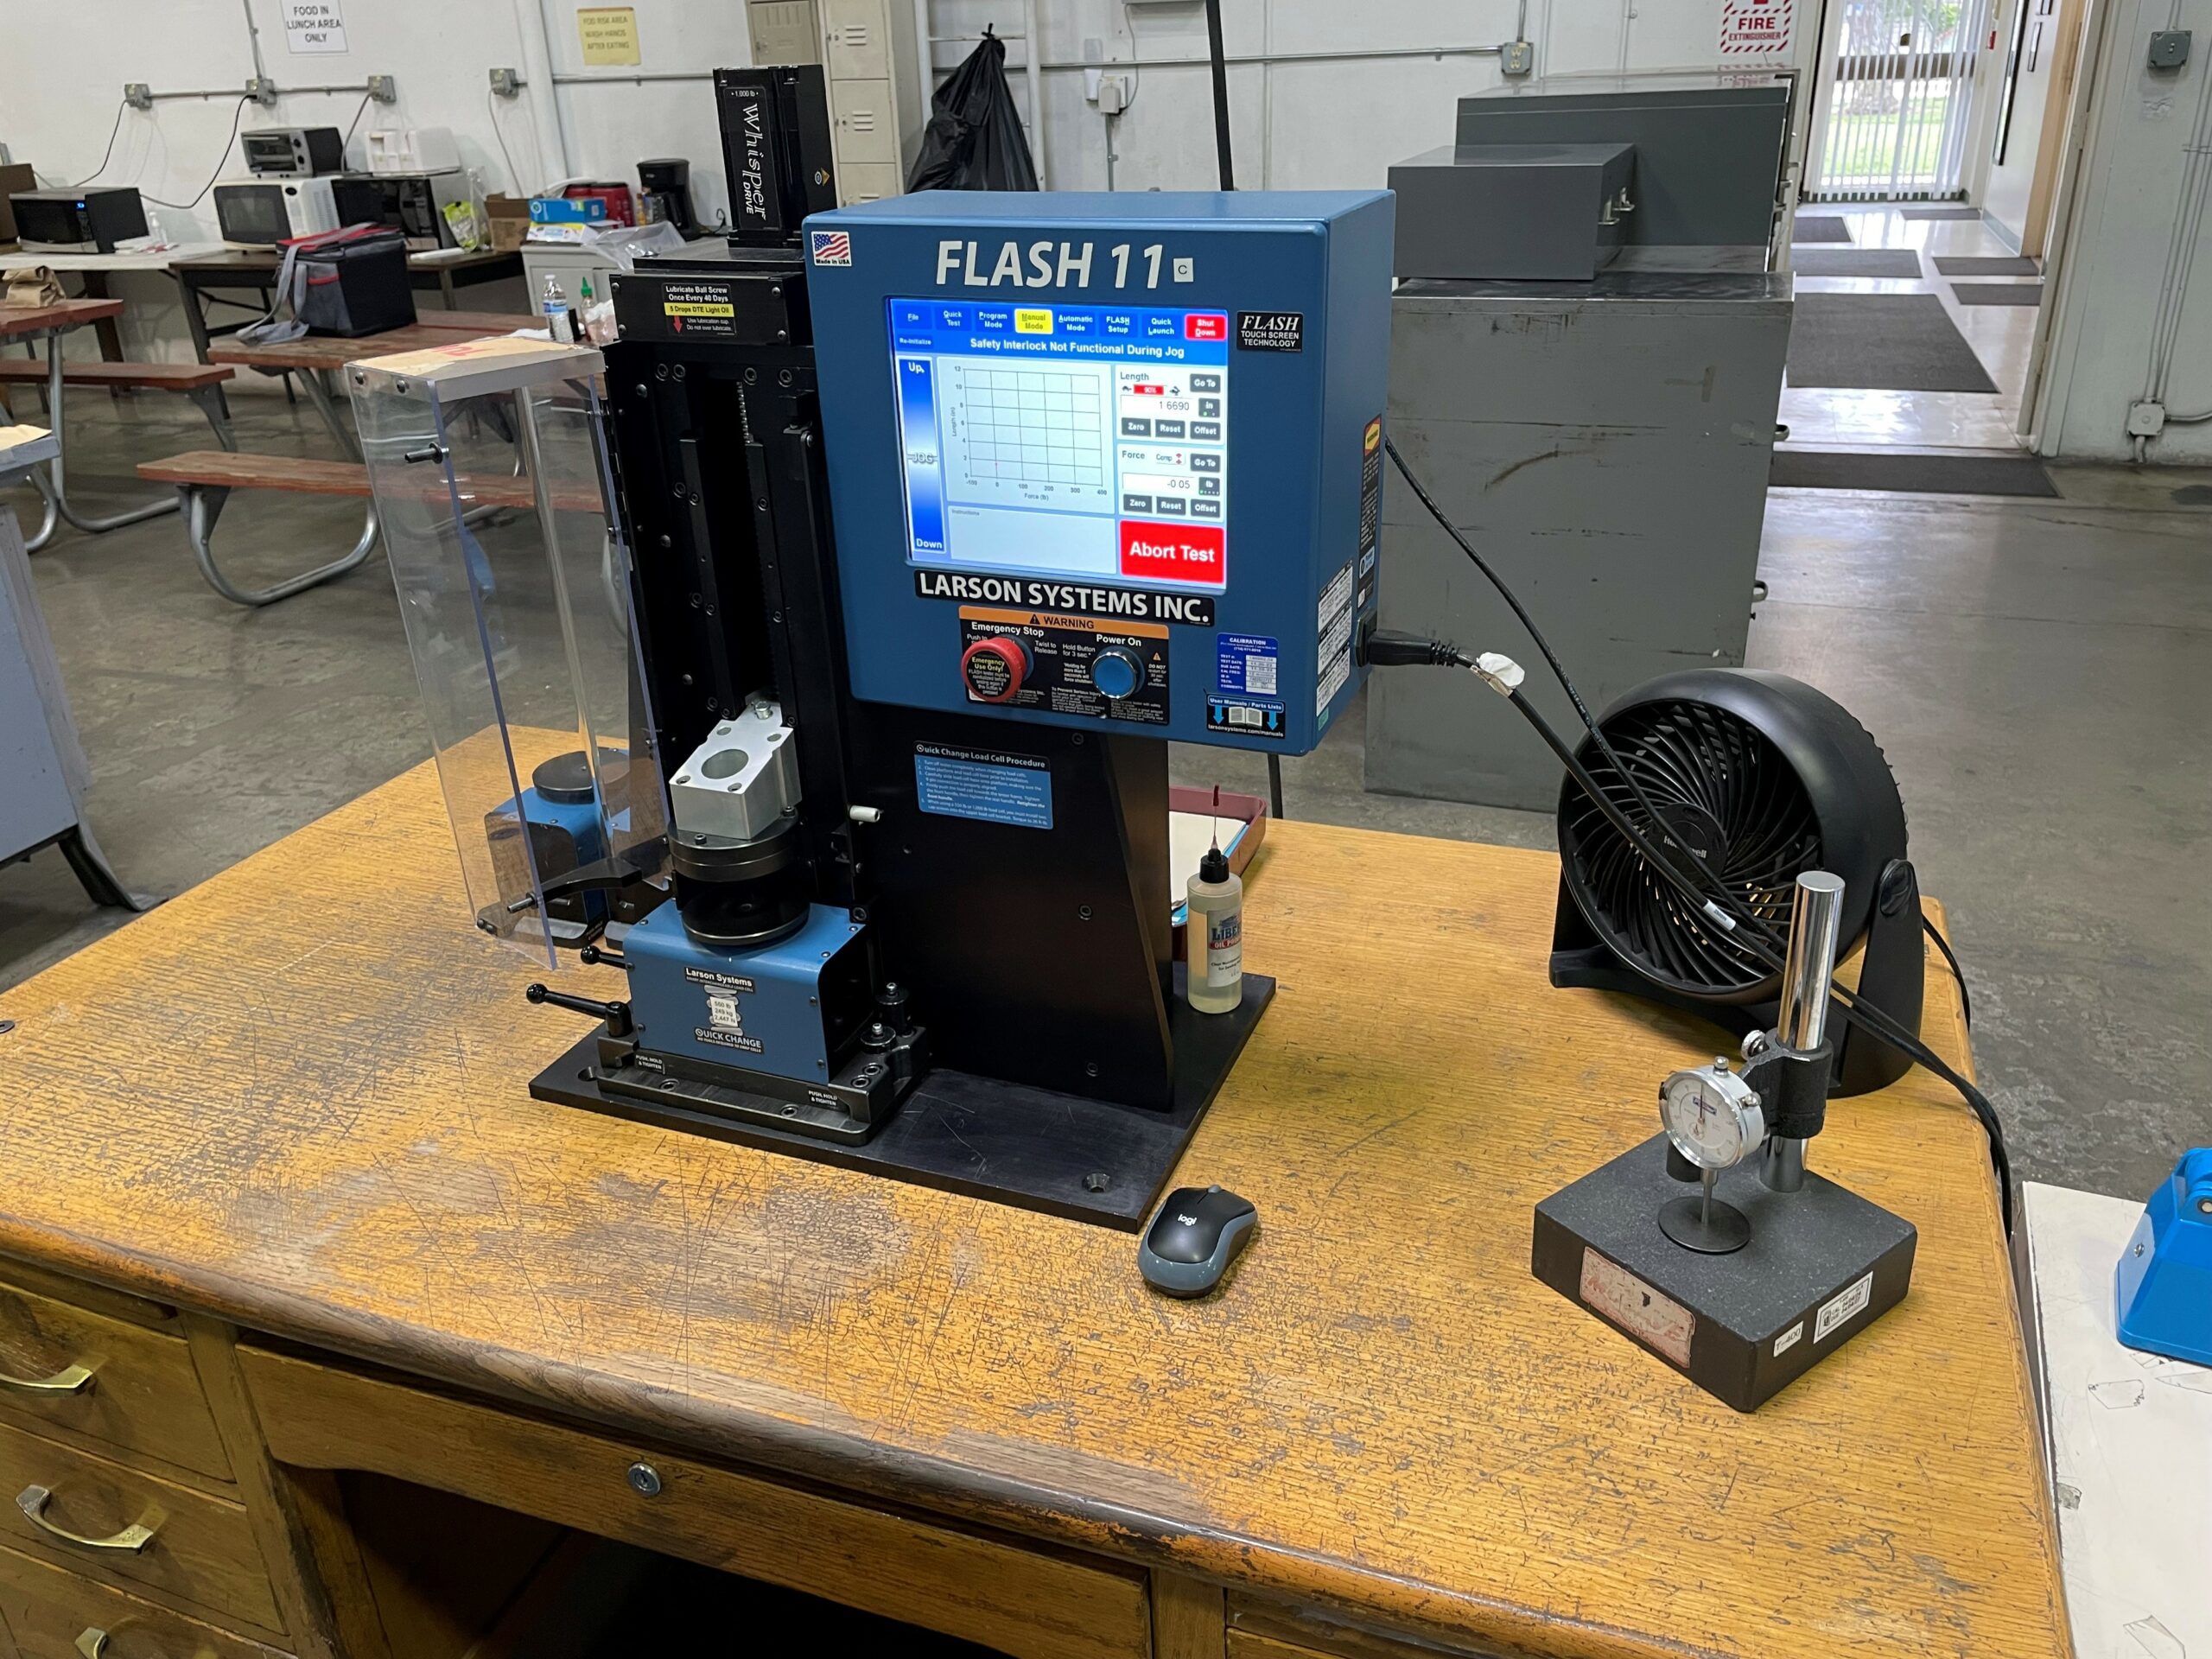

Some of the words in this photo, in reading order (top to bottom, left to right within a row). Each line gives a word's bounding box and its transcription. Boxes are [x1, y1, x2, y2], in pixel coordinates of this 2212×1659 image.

[294, 6, 318, 16] FOOD
[320, 6, 328, 15] IN
[287, 20, 315, 29] LUNCH
[318, 19, 342, 28] AREA
[1738, 17, 1776, 29] FIRE
[305, 33, 327, 42] ONLY
[1729, 32, 1780, 41] EXTINGUISHER
[742, 103, 766, 220] Whisper
[742, 182, 753, 214] DRIVE
[936, 240, 1093, 288] FLASH
[1111, 245, 1163, 289] 11
[944, 310, 962, 319] Quick
[979, 312, 1007, 321] Program
[1106, 316, 1129, 325] FLASH
[1197, 319, 1214, 327] Shut
[1242, 315, 1300, 331] FLASH
[1195, 328, 1216, 337] Down
[1244, 339, 1296, 347] TECHNOLOGY
[970, 339, 1001, 352] Safety
[1003, 340, 1046, 352] Interlock
[1051, 342, 1067, 352] Not
[1070, 342, 1123, 355] Functional
[1128, 345, 1162, 358] During
[1166, 347, 1185, 359] Jog
[908, 362, 922, 373] Up
[1121, 372, 1149, 382] Length
[1194, 378, 1205, 387] Go
[1160, 401, 1189, 410] 16690
[1160, 424, 1180, 433] Reset
[1194, 426, 1217, 435] Offset
[912, 452, 933, 463] JOG
[1122, 450, 1145, 459] Force
[1194, 458, 1205, 467] Go
[1207, 459, 1216, 467] To
[1167, 479, 1190, 489] -005
[1161, 501, 1181, 510] Reset
[1195, 504, 1217, 512] Offset
[916, 538, 942, 550] Down
[1129, 541, 1176, 559] Abort
[1179, 545, 1214, 563] Test
[919, 572, 1021, 602] LARSON
[1028, 583, 1148, 615] SYSTEMS
[1155, 595, 1210, 622] INC.
[1044, 616, 1094, 630] WARNING
[972, 622, 1020, 635] Emergency
[1023, 626, 1044, 638] Stop
[1096, 634, 1124, 645] Power
[1128, 638, 1141, 646] On
[972, 657, 1005, 666] Emergency
[916, 744, 940, 754] Quick
[941, 748, 969, 759] Change
[971, 752, 989, 761] Load
[1006, 757, 1046, 768] Procedure
[686, 968, 715, 980] Larson
[716, 974, 753, 987] Systems
[696, 1028, 724, 1040] QUICK
[725, 1034, 761, 1048] CHANGE
[1178, 1214, 1197, 1226] logi
[1777, 1328, 1801, 1351] T-400
